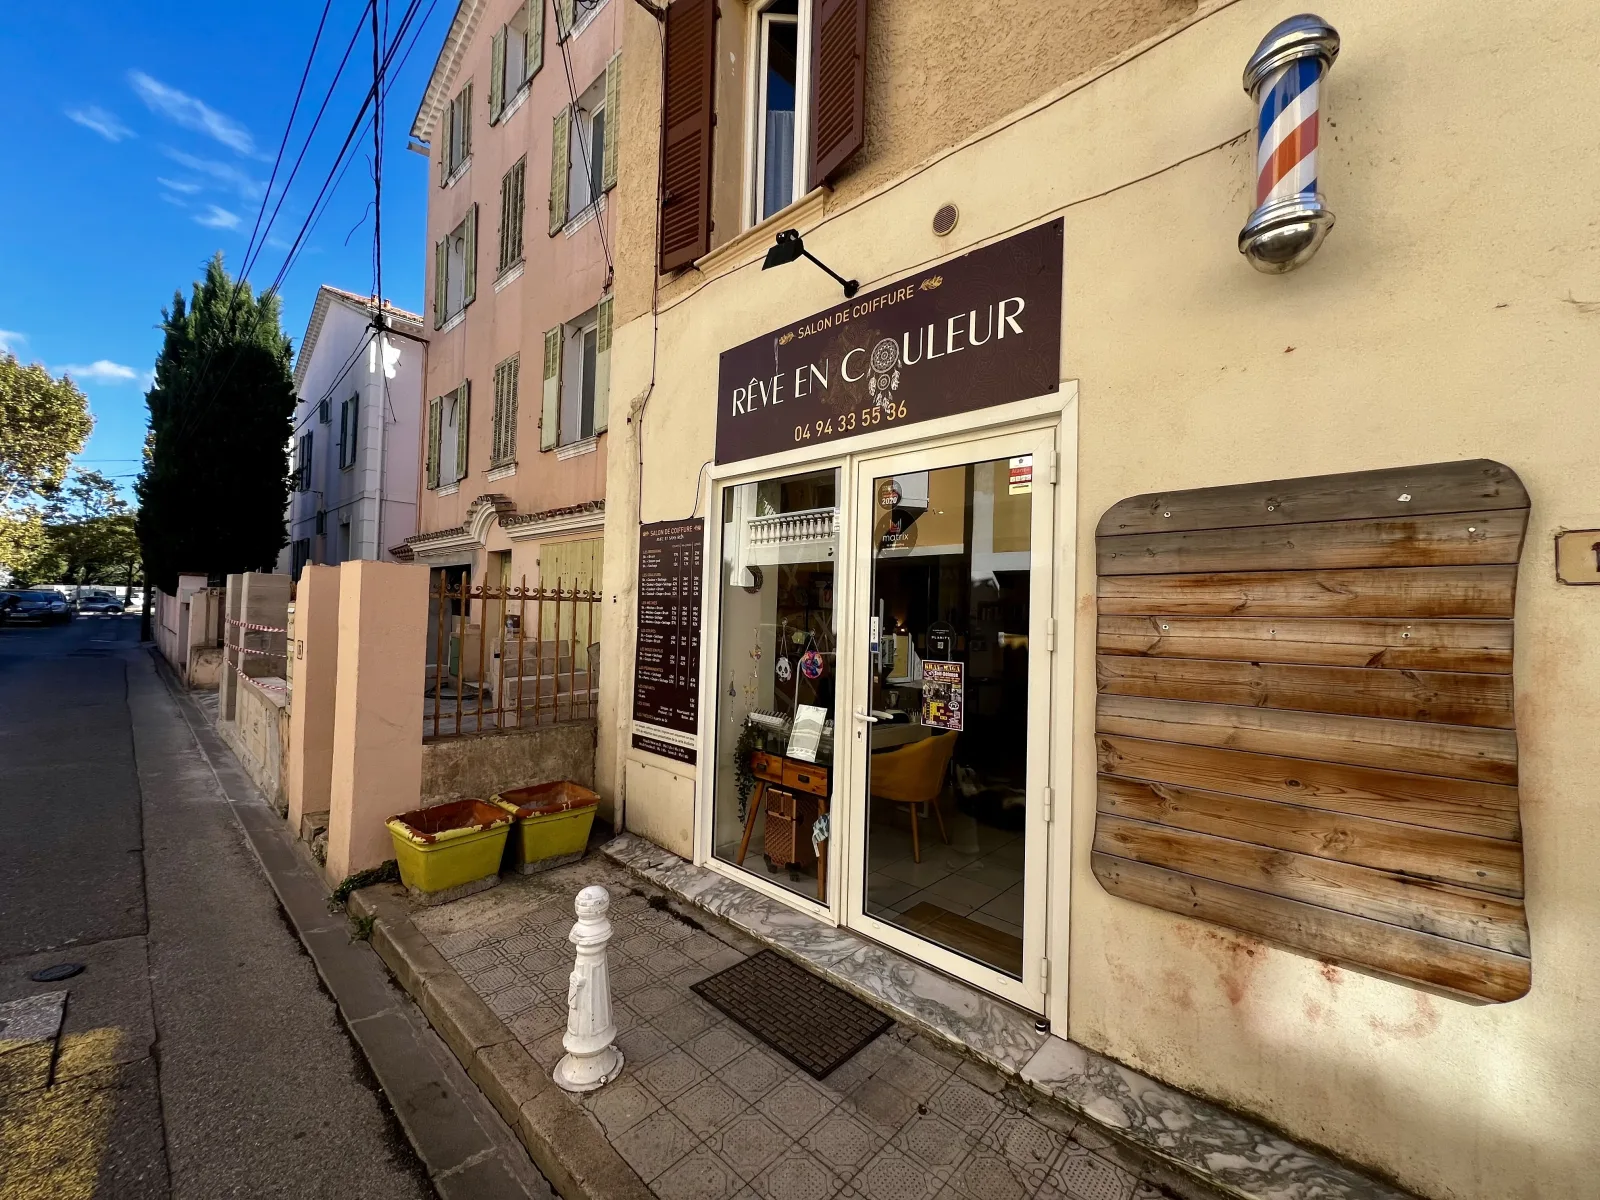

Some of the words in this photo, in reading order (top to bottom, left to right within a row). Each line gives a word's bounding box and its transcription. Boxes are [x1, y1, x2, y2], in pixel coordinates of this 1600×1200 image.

[797, 319, 832, 340] SALON
[834, 310, 850, 331] DE
[852, 284, 914, 318] COIFFURE
[732, 373, 785, 417] RÊVE
[795, 358, 829, 399] EN
[794, 425, 811, 442] 04
[816, 419, 833, 437] 94
[838, 413, 856, 432] 33
[861, 407, 881, 427] 55
[886, 400, 908, 422] 36
[882, 497, 897, 505] 2020
[650, 528, 664, 537] SALON
[670, 525, 693, 535] COIFFURE
[882, 533, 909, 541] matrix
